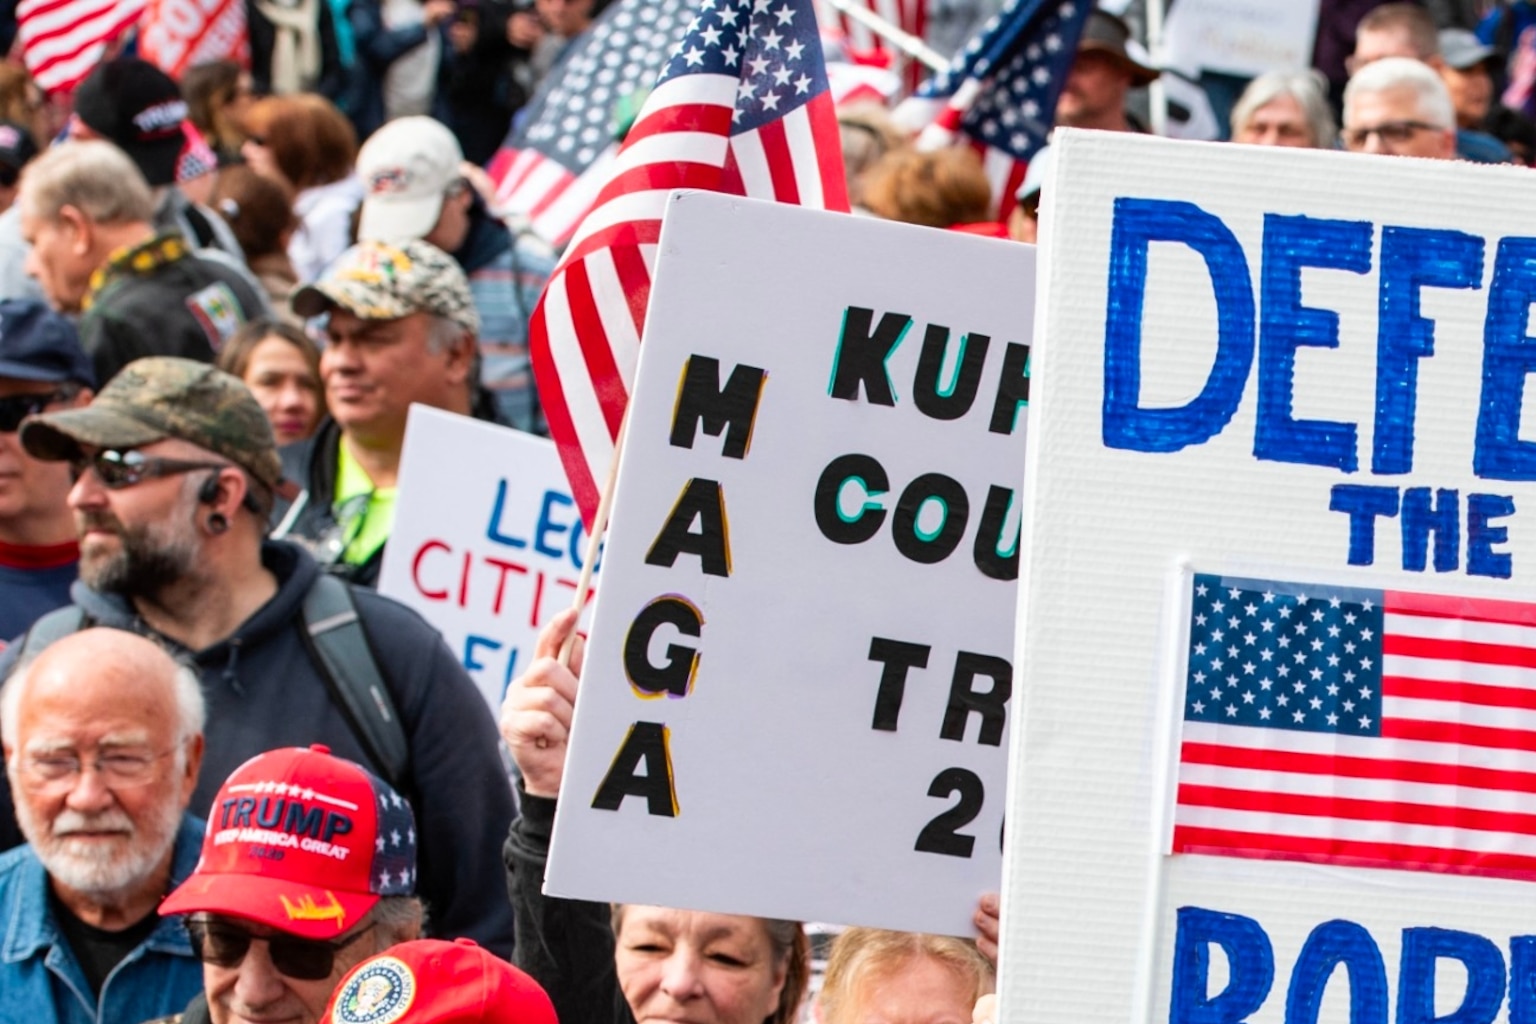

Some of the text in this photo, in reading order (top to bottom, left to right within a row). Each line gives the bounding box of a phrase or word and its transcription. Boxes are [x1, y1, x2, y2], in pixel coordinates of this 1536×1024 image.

[1329, 484, 1516, 580] THE
[221, 795, 354, 842] TRUMP
[239, 828, 299, 848] AMERICA
[300, 839, 350, 861] GREAT
[914, 767, 1006, 859] 2
